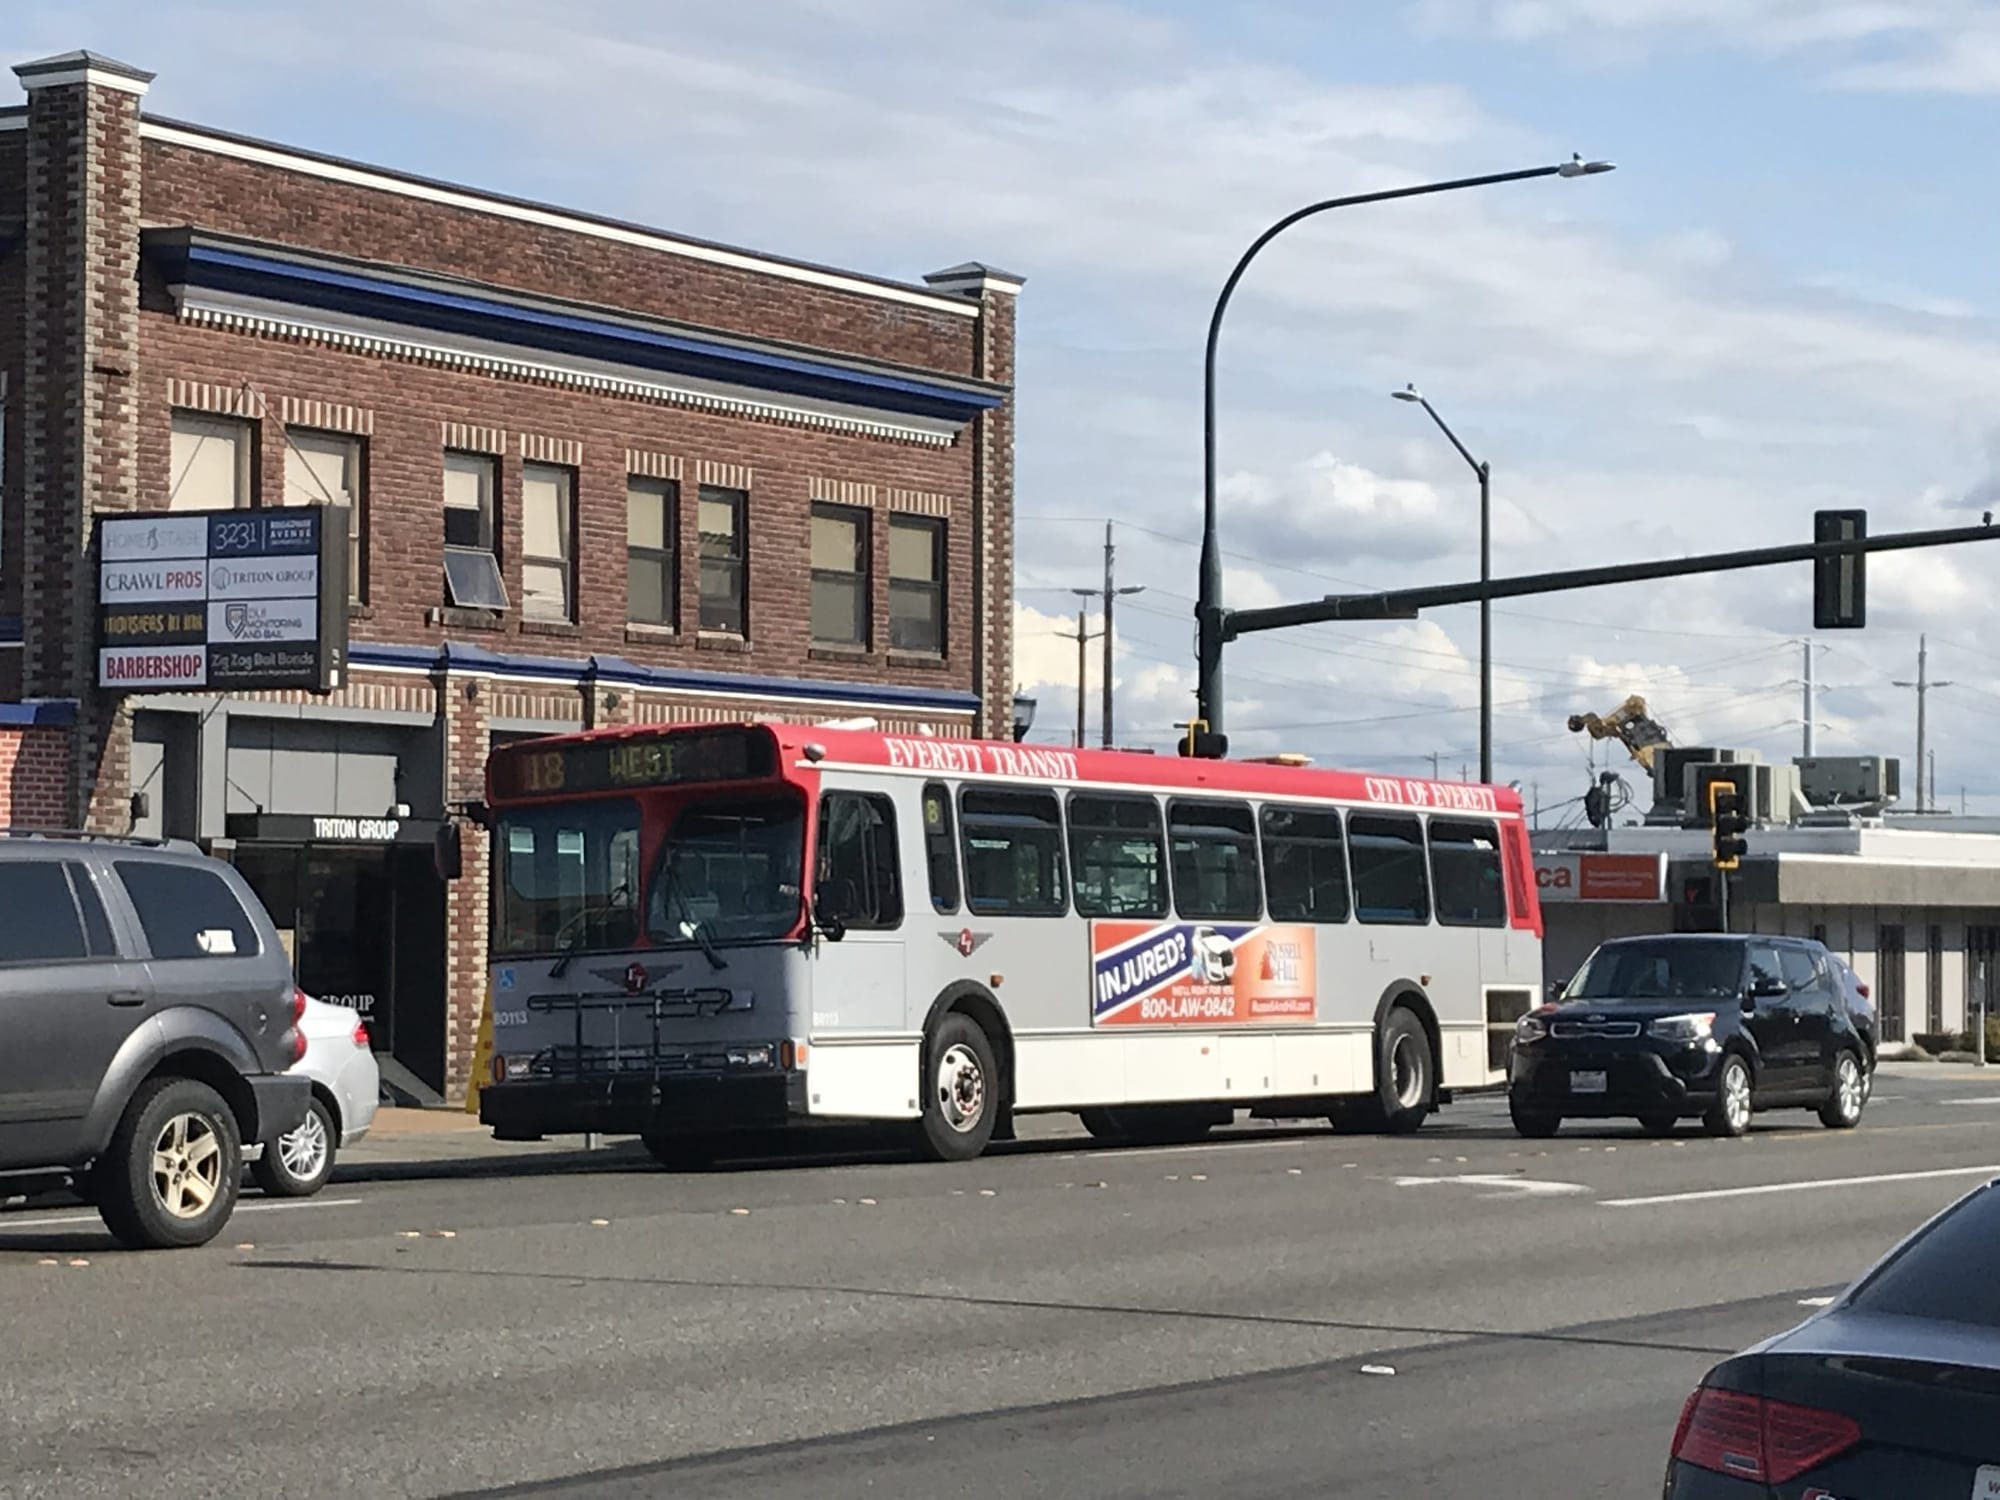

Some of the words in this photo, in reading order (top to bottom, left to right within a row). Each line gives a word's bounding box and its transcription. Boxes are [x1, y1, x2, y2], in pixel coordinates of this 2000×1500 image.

[215, 522, 256, 550] 3231
[270, 529, 312, 538] AVENUE
[105, 572, 163, 591] CRAWL
[166, 571, 203, 589] PROS
[233, 571, 274, 584] TRITON
[275, 569, 315, 583] GROUP
[106, 655, 202, 680] BARBERSHOP
[277, 651, 315, 666] Bonds
[609, 744, 674, 779] WEST
[883, 738, 985, 773] EVERETT
[985, 746, 1078, 780] TRANSIT
[1365, 777, 1403, 803] CITY
[1405, 780, 1428, 805] OF
[1429, 782, 1498, 811] EVERETT
[313, 818, 357, 839] TRITON
[358, 819, 399, 840] GROUP
[1098, 932, 1187, 1003] INJURED?
[1141, 997, 1235, 1018] 800-LAW-0842
